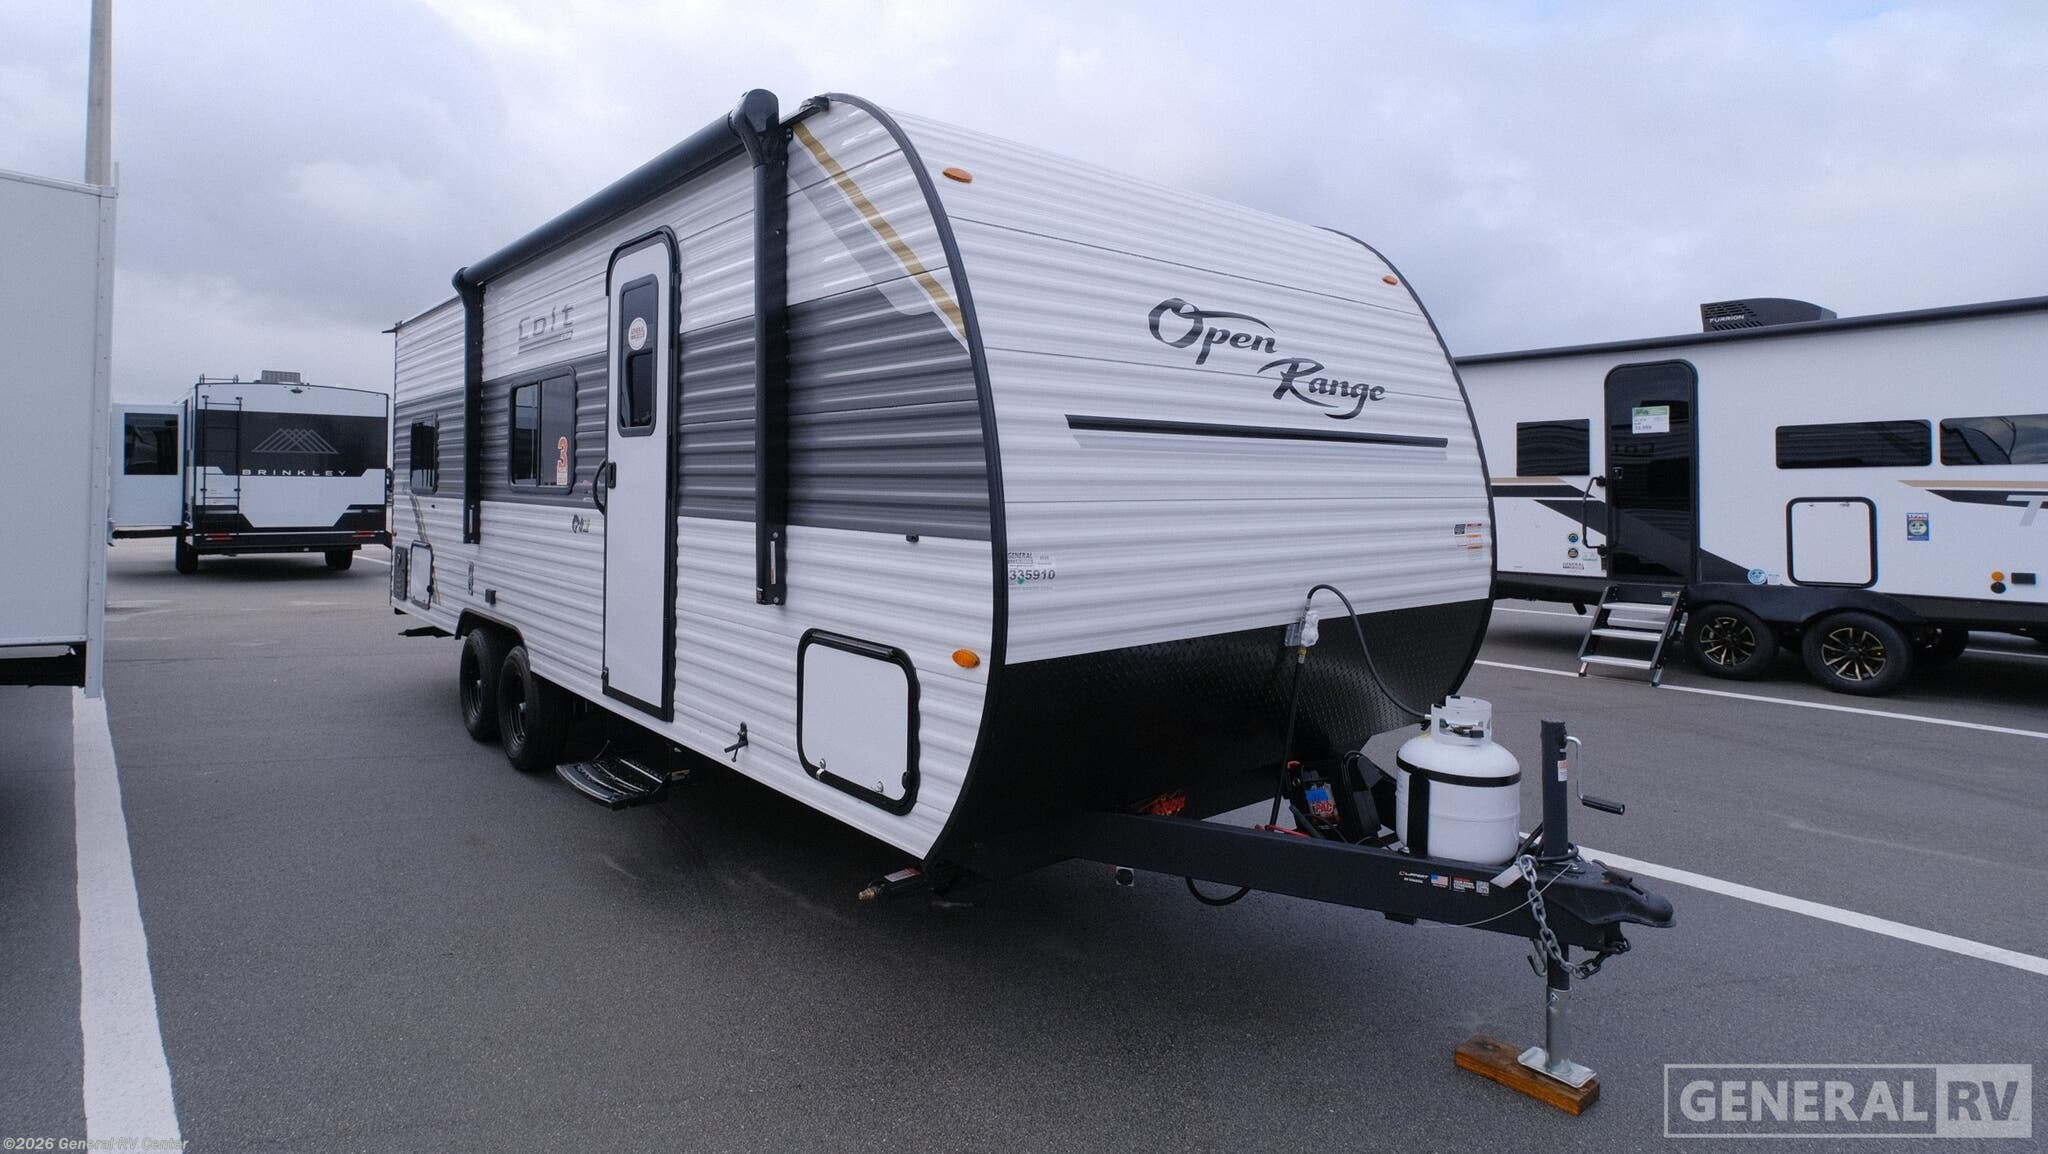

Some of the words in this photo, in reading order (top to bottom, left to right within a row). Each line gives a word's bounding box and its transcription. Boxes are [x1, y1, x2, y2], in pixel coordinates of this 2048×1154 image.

[1148, 297, 1277, 365] Open
[1257, 358, 1386, 420] Range
[241, 469, 348, 477] BRINKLEY
[1009, 569, 1056, 581] 335910
